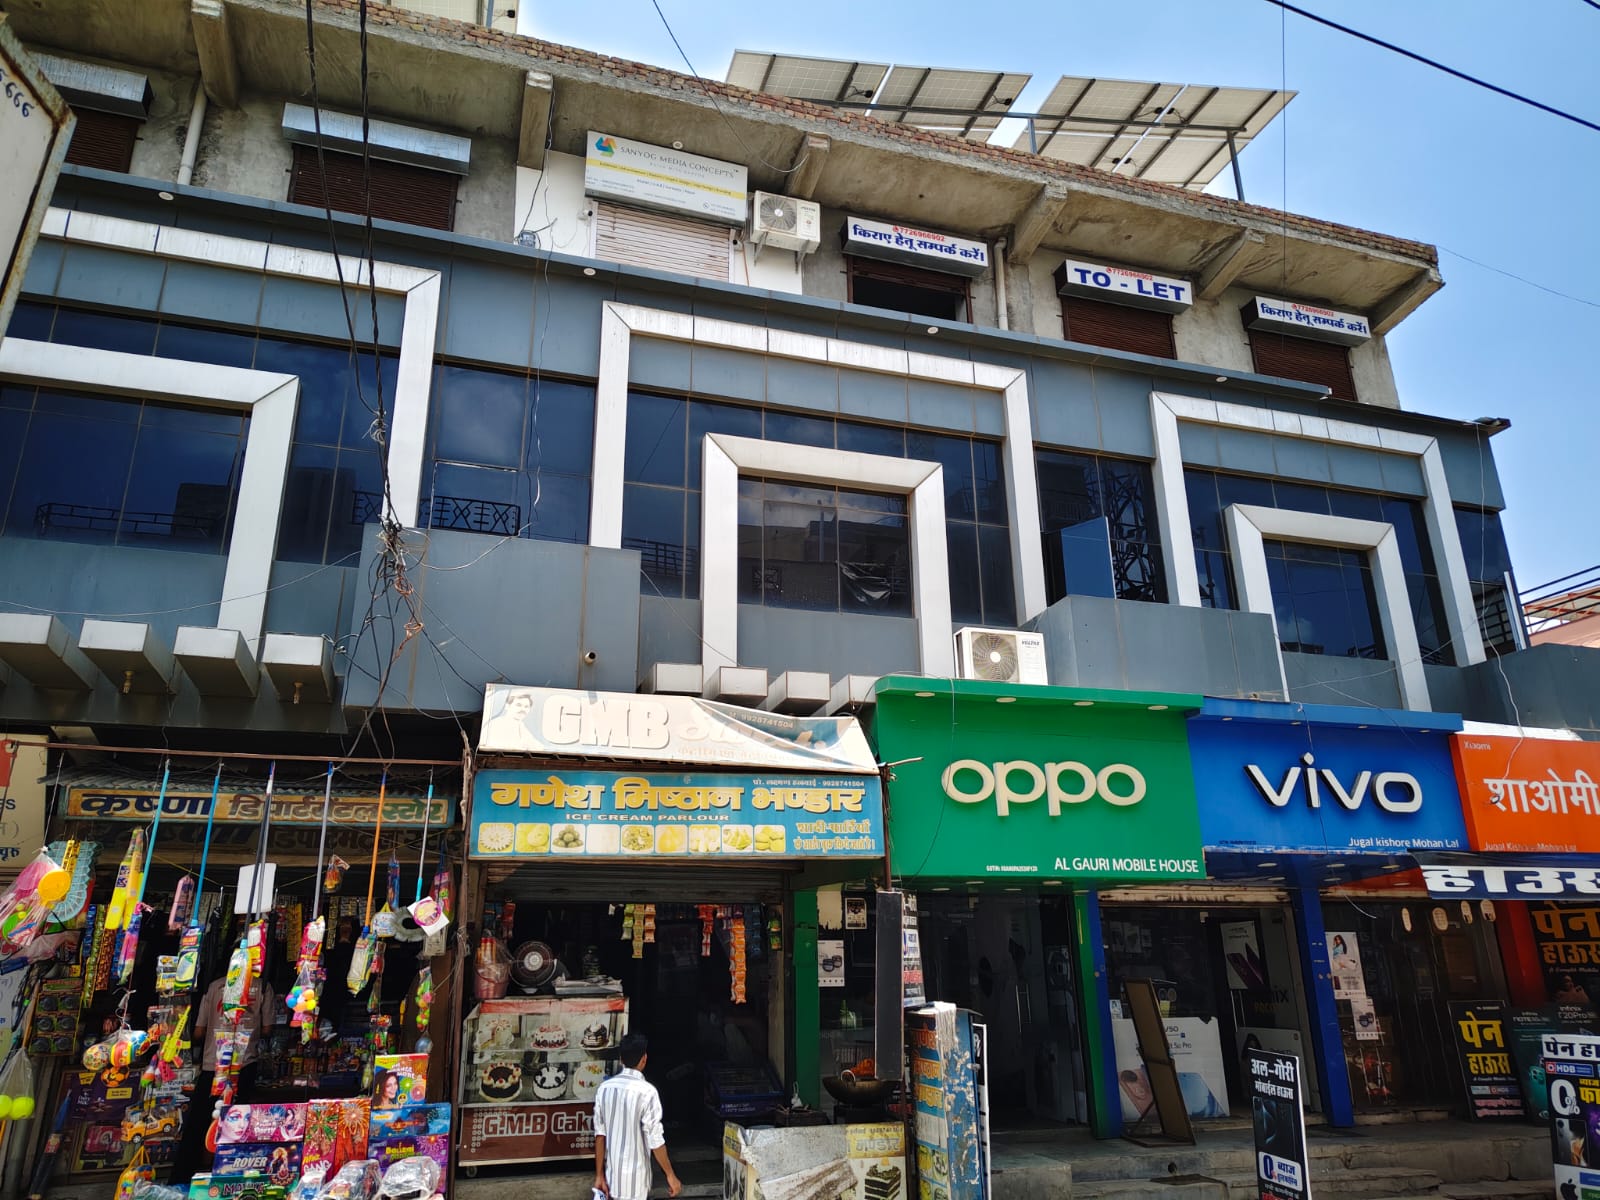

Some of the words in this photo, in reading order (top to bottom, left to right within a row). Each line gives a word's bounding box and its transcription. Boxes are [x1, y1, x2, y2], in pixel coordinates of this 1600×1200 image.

[620, 146, 657, 161] SANYOG
[659, 156, 687, 168] MEDIA
[853, 224, 892, 244] किराए
[917, 240, 957, 255] सम्पर्क
[1074, 268, 1111, 287] TO
[1137, 279, 1185, 301] LET
[1260, 303, 1293, 320] किराए
[1313, 316, 1345, 329] सम्पर्क
[542, 694, 671, 750] GMB
[1463, 741, 1491, 750] Xiaomi
[1244, 752, 1423, 814] vivo
[1483, 768, 1600, 816] शाओमी
[491, 776, 605, 810] गणेश
[612, 777, 744, 811] मिष्ठान
[752, 787, 866, 814] भण्डार
[566, 813, 591, 821] ICE
[658, 814, 729, 822] PARLOUR
[1348, 837, 1374, 848] Jugal
[1375, 837, 1411, 847] kishore
[1412, 838, 1444, 848] Mohan
[1445, 839, 1460, 848] Lal
[1054, 858, 1070, 871] AL
[1072, 858, 1109, 872] GAURI
[1112, 859, 1156, 873] MOBILE
[1159, 860, 1200, 873] HOUSE
[1457, 1010, 1505, 1049] पेन
[1544, 1037, 1576, 1056] पेन
[1466, 1052, 1512, 1075] हाऊस
[1556, 1064, 1576, 1073] HDB
[232, 1156, 268, 1169] ROVER
